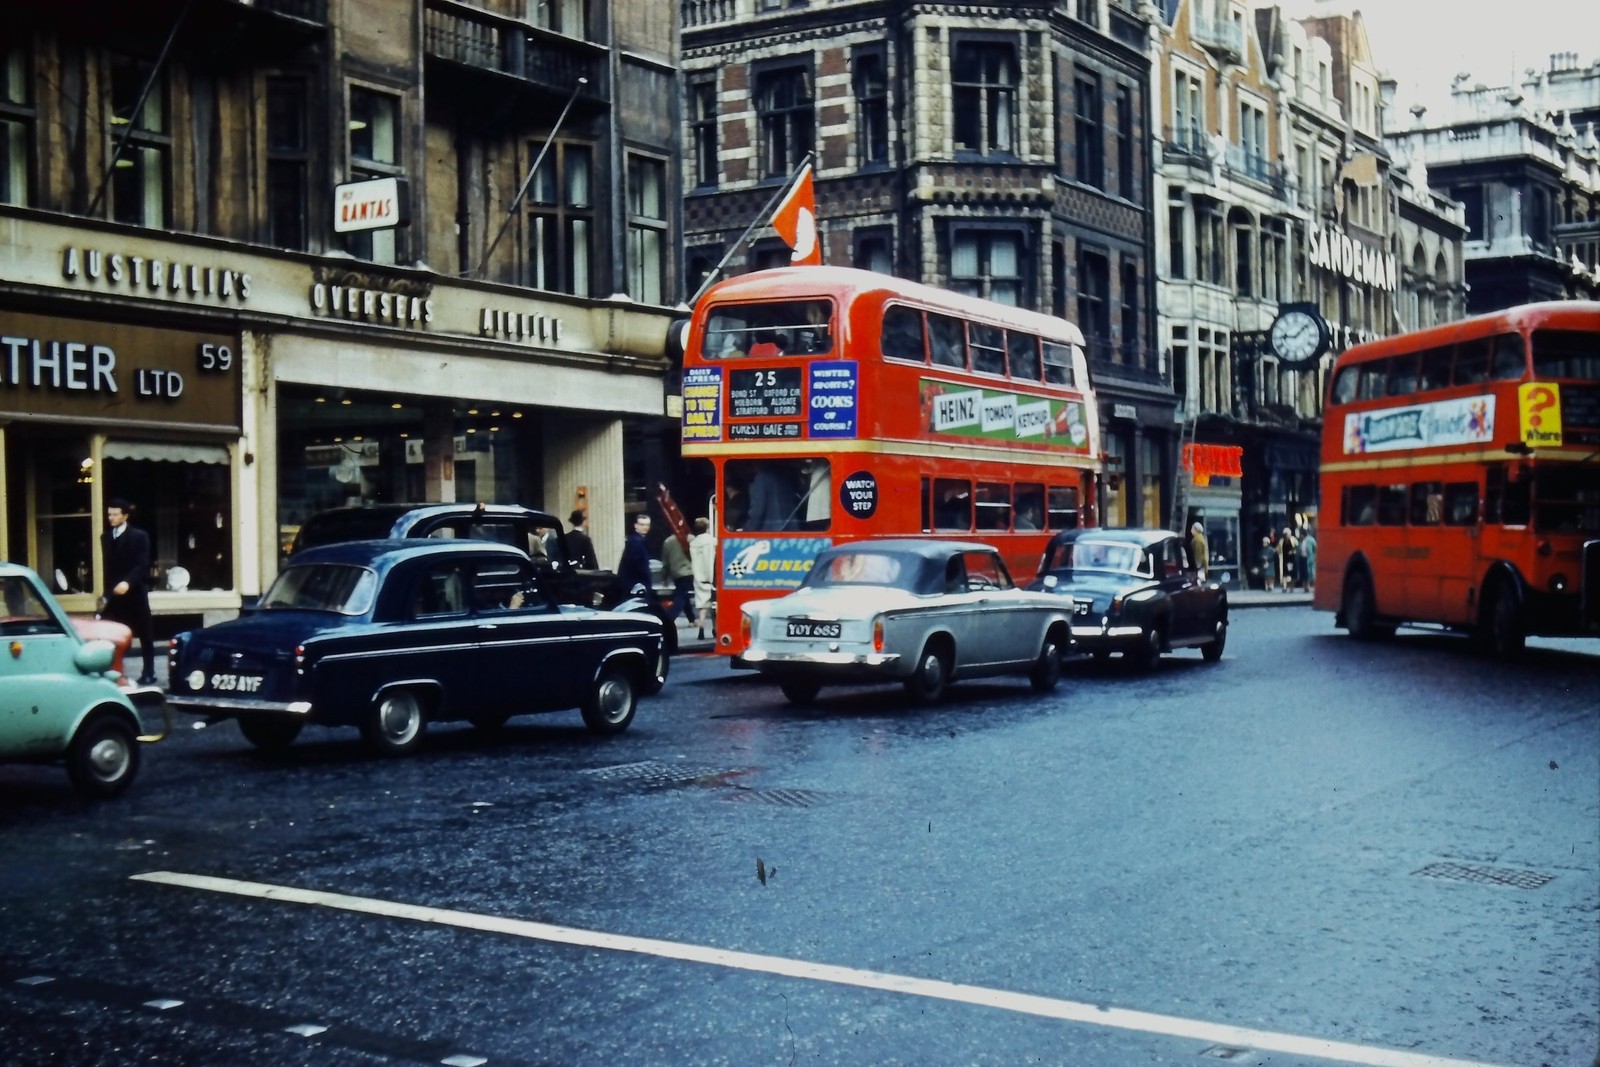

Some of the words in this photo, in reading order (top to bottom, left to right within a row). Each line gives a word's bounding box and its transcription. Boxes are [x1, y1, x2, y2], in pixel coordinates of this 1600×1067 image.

[342, 198, 391, 222] QANTAS
[1309, 220, 1397, 292] SANDEMAN
[67, 247, 252, 298] AUSTRALIA'S
[313, 283, 433, 323] OVERSEAS
[201, 343, 233, 371] 59
[0, 335, 118, 393] THER
[139, 368, 184, 397] LTD
[754, 371, 777, 387] 25
[813, 369, 850, 377] WINTER
[813, 380, 855, 390] SPORTS?
[731, 390, 747, 398] BOND
[749, 389, 757, 397] ST
[763, 388, 788, 397] OXFORD
[734, 399, 762, 407] HOLBORN
[771, 397, 797, 406] ALDGATE
[811, 395, 854, 408] COOKS
[735, 407, 768, 415] STRATFORD
[774, 406, 796, 414] ILFORD
[940, 397, 974, 424] HEINZ
[985, 404, 1014, 422] TOMATO
[1018, 409, 1048, 429] KETCHUP
[763, 424, 783, 436] GATE
[845, 480, 875, 489] WATCH
[850, 491, 873, 500] YOUR
[853, 501, 872, 510] STEP
[755, 559, 815, 572] DUNLO
[211, 674, 237, 690] 923
